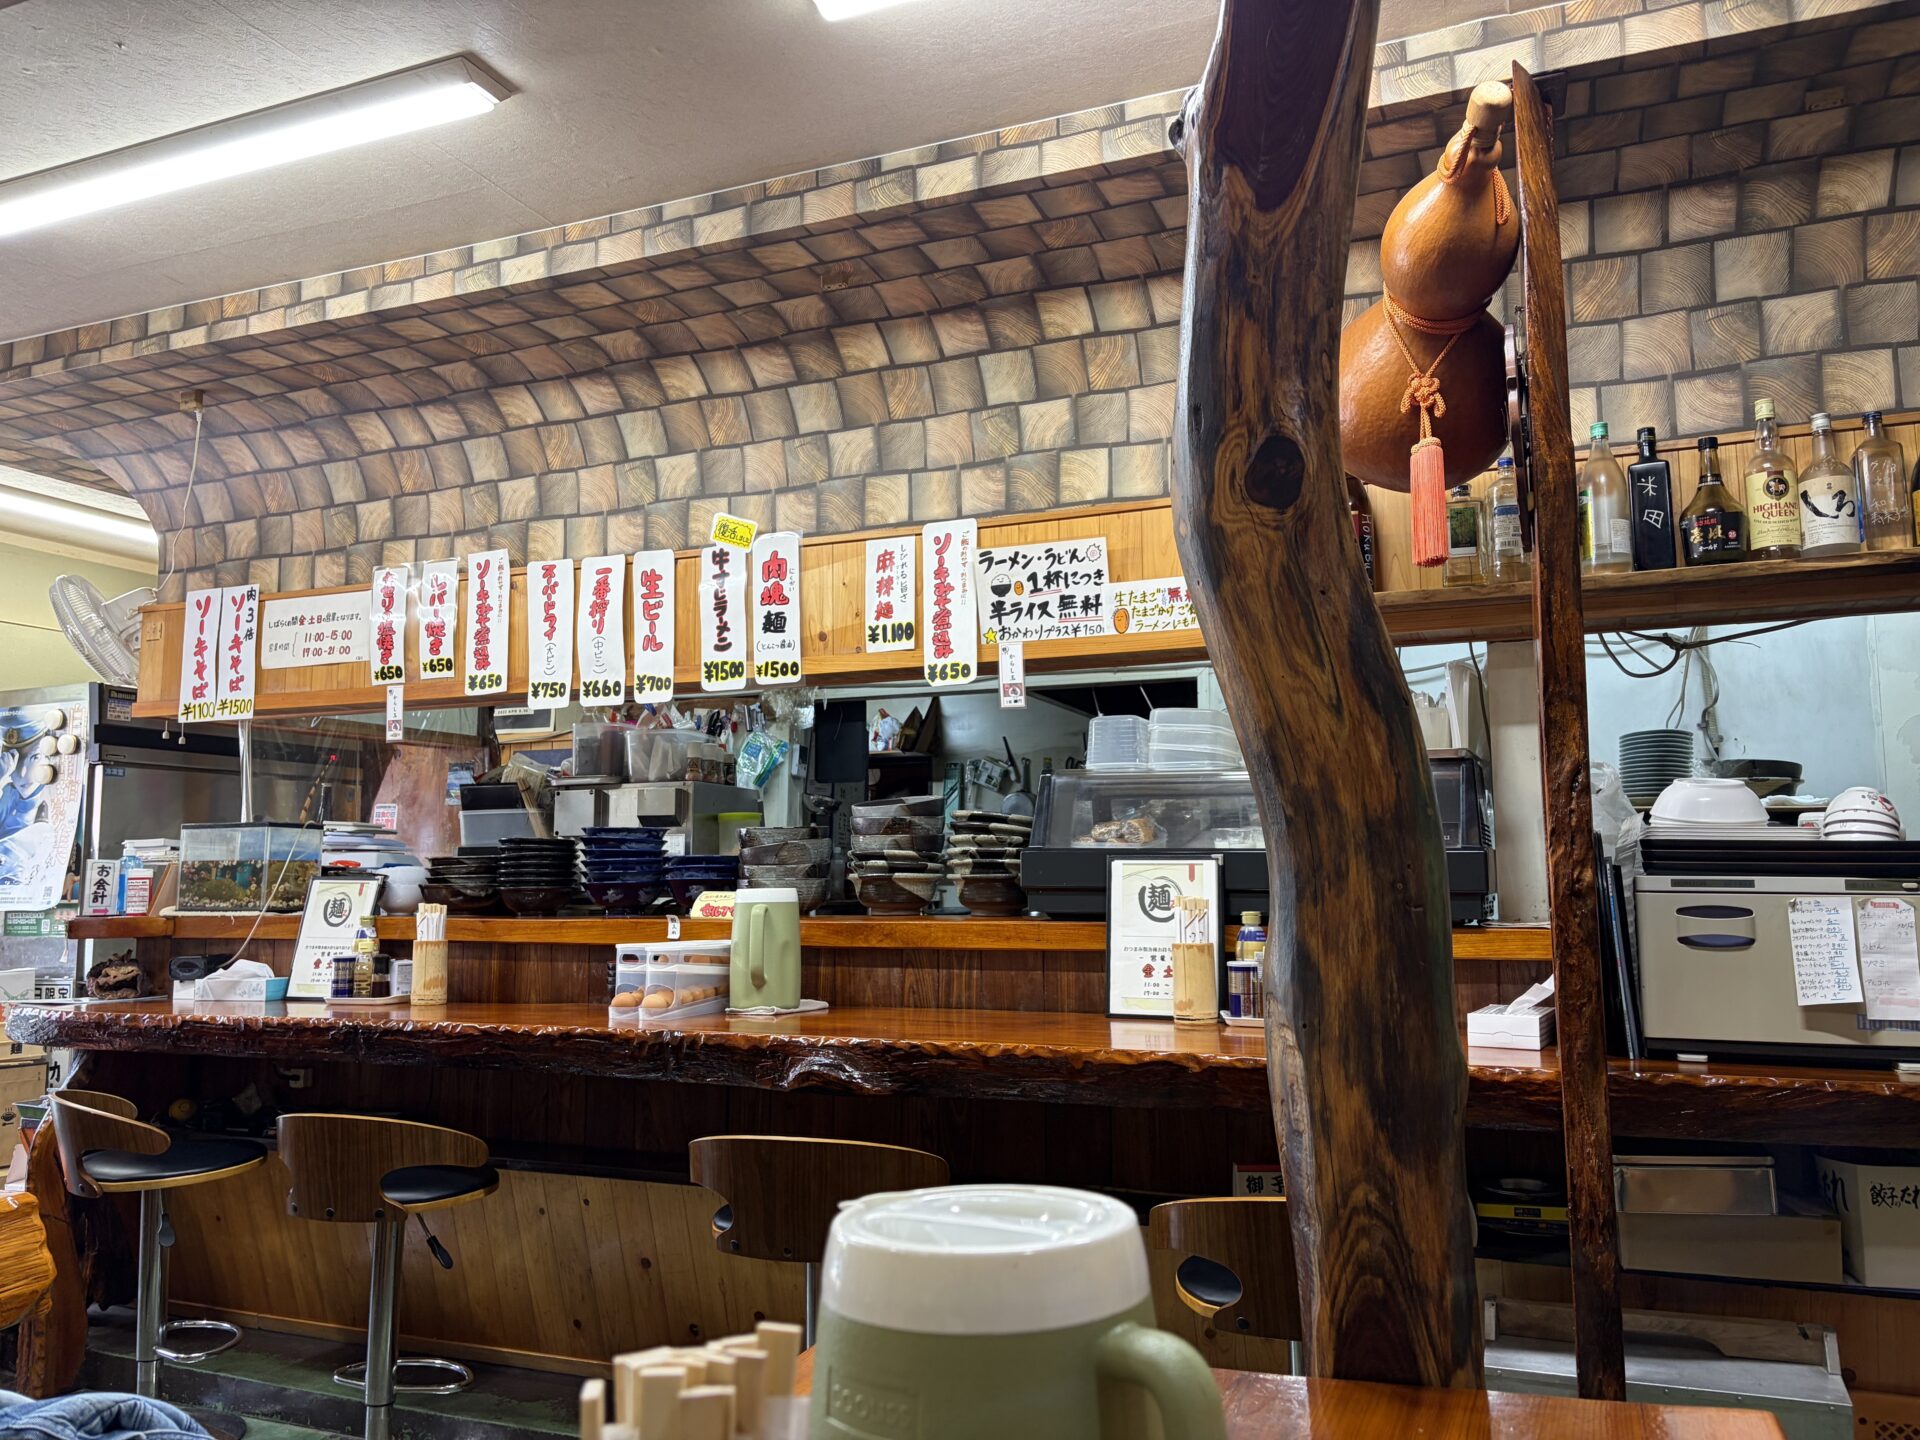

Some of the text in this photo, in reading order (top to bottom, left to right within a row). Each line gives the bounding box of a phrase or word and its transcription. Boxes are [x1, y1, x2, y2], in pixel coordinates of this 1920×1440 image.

[1637, 476, 1664, 528] 米田
[1762, 510, 1795, 519] QUEEN
[979, 547, 1086, 574] ラーメン・うどん
[1027, 569, 1104, 594] 1杯につき
[541, 564, 559, 640] スーパードライ
[589, 567, 612, 635] 一番搾り
[712, 548, 732, 652] 牛すじラーメン
[932, 532, 955, 659] ソーキみそ煮込み
[244, 587, 257, 641] 肉3倍
[425, 574, 447, 655] レバー焼き
[641, 568, 664, 652] 生ビール
[989, 594, 1103, 625] 半ライス 無料
[192, 595, 212, 700] ソーキそば
[228, 593, 247, 693] ソーキそば
[374, 666, 403, 680] ¥650
[422, 658, 453, 672] ¥650
[704, 661, 744, 683] ¥1500
[756, 661, 799, 678] ¥1500
[927, 663, 971, 682] ¥650
[468, 674, 502, 691] ¥650
[531, 682, 566, 699] ¥750
[583, 680, 621, 698] ¥660
[636, 675, 671, 694] ¥700
[181, 701, 216, 720] ¥1100
[217, 699, 252, 716] ¥1500
[92, 865, 111, 904] お会計
[1148, 883, 1172, 912] 麺
[328, 897, 347, 919] 麺
